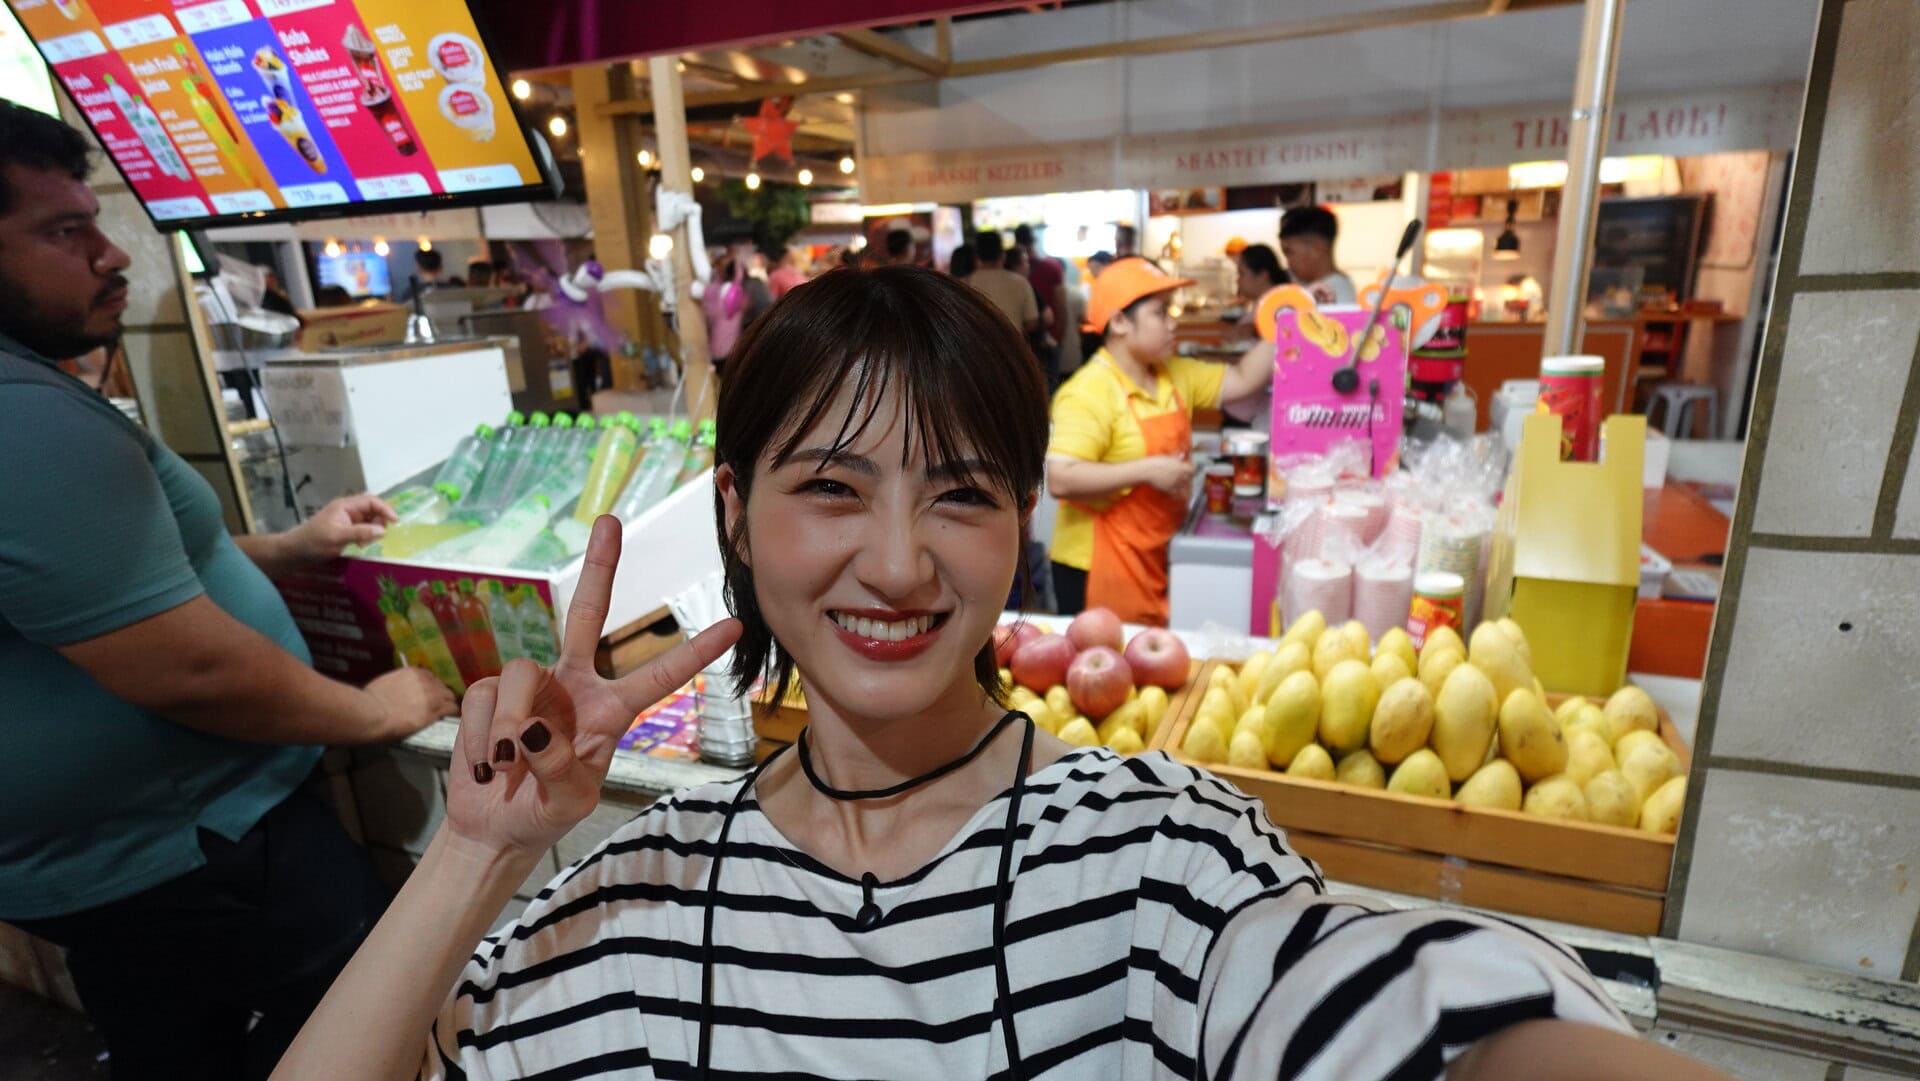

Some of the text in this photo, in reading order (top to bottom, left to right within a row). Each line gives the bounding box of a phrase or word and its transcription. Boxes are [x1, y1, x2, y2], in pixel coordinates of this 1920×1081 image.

[280, 29, 310, 47] Boba
[290, 48, 330, 66] Shakes
[128, 61, 157, 77] Fresh
